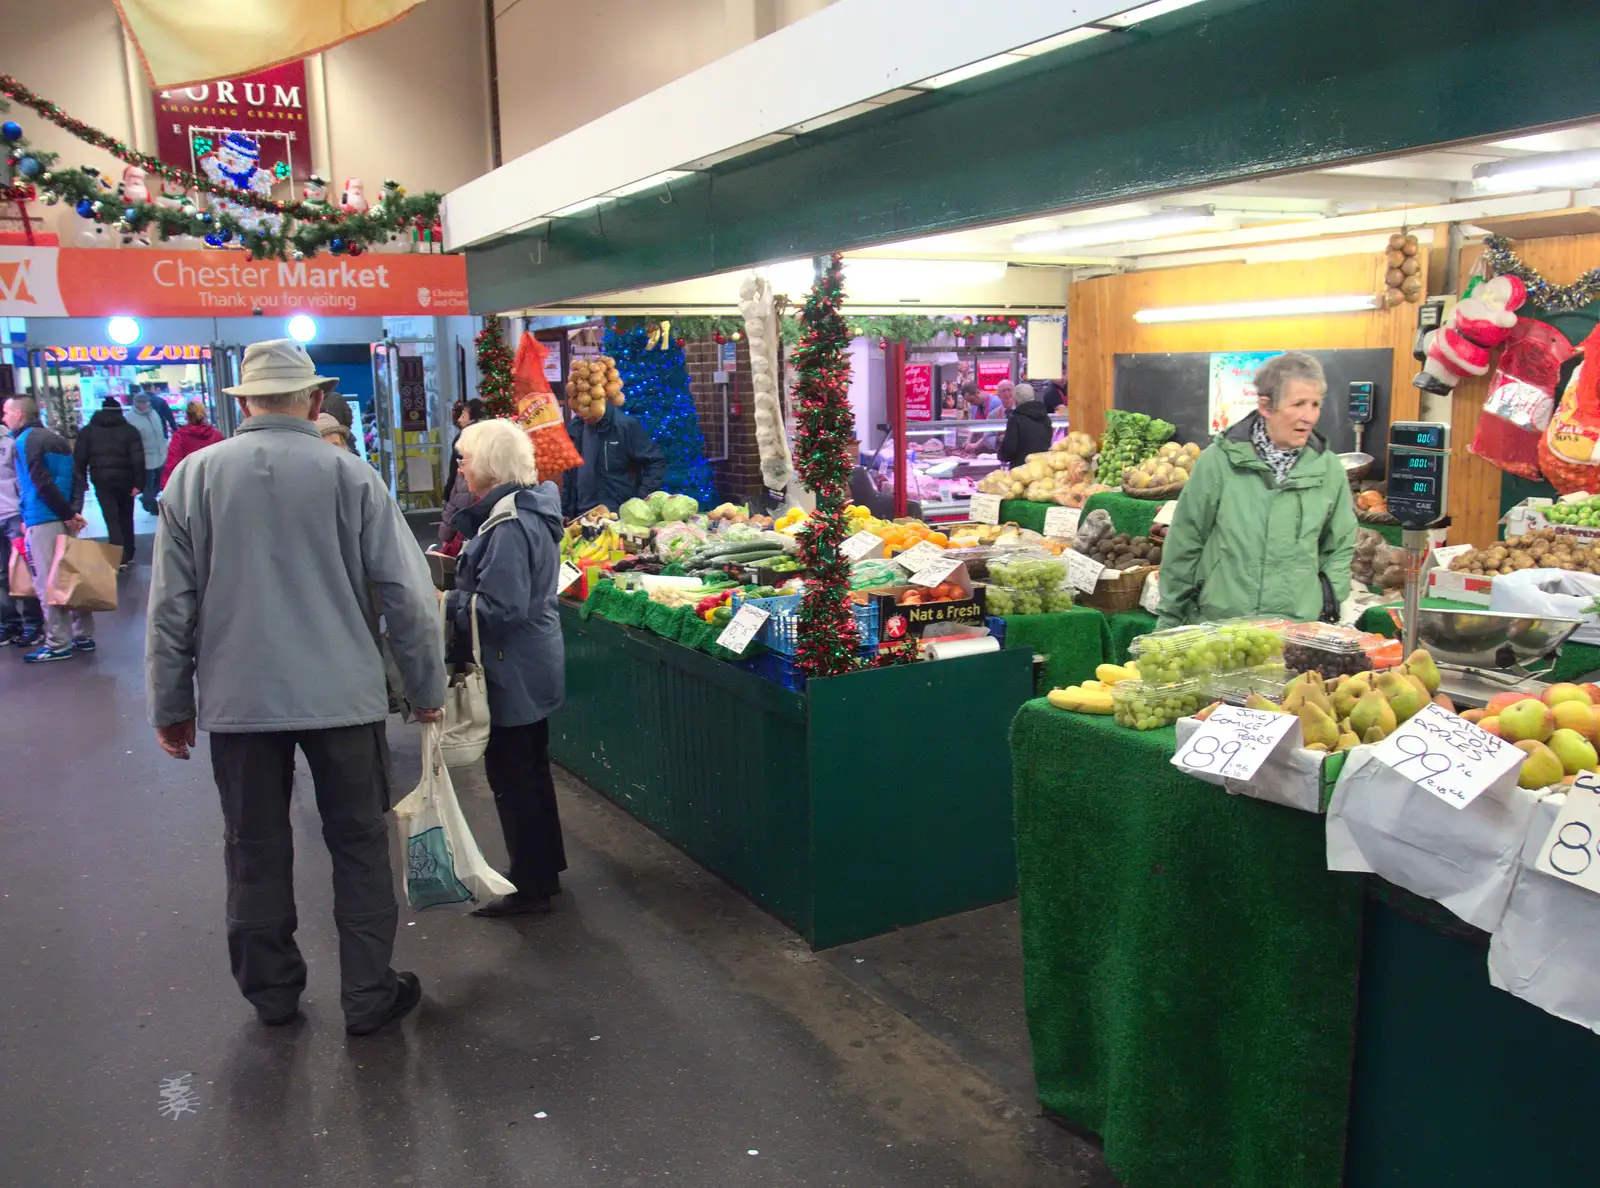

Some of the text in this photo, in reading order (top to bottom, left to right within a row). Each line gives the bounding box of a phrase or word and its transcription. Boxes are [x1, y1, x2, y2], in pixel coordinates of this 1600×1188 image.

[247, 110, 304, 121] CENTRE
[152, 259, 390, 289] Chester Market
[199, 291, 357, 310] Thank you for visiting
[909, 608, 934, 622] Nat
[936, 609, 944, 620] &
[946, 603, 981, 618] Fresh
[1181, 735, 1243, 774] 89
[1390, 734, 1452, 784] 99
